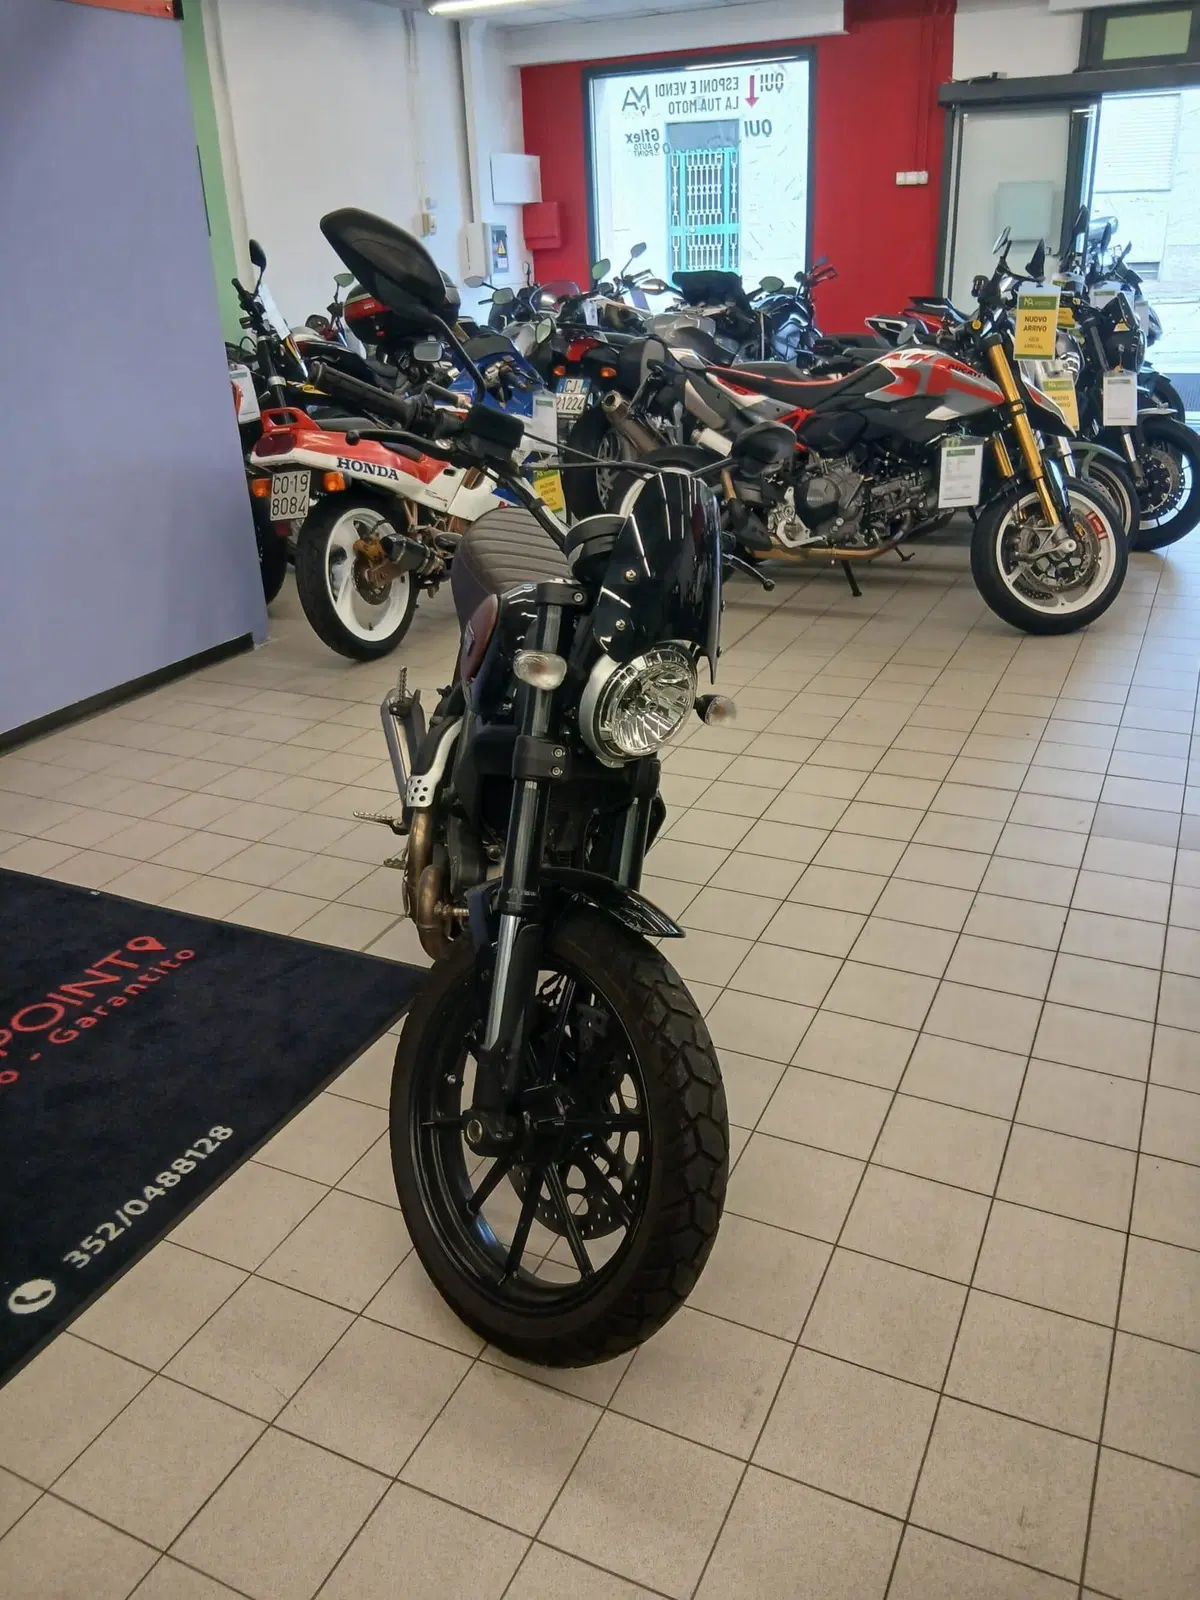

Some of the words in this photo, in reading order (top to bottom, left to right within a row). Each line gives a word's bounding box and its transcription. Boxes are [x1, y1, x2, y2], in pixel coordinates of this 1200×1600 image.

[1023, 325, 1047, 333] ARRIVO
[1024, 315, 1048, 323] NUOVO
[336, 456, 400, 481] HONDA
[272, 495, 307, 516] 8084
[48, 950, 196, 1044] Garantito
[63, 1125, 234, 1269] 352/0488128
